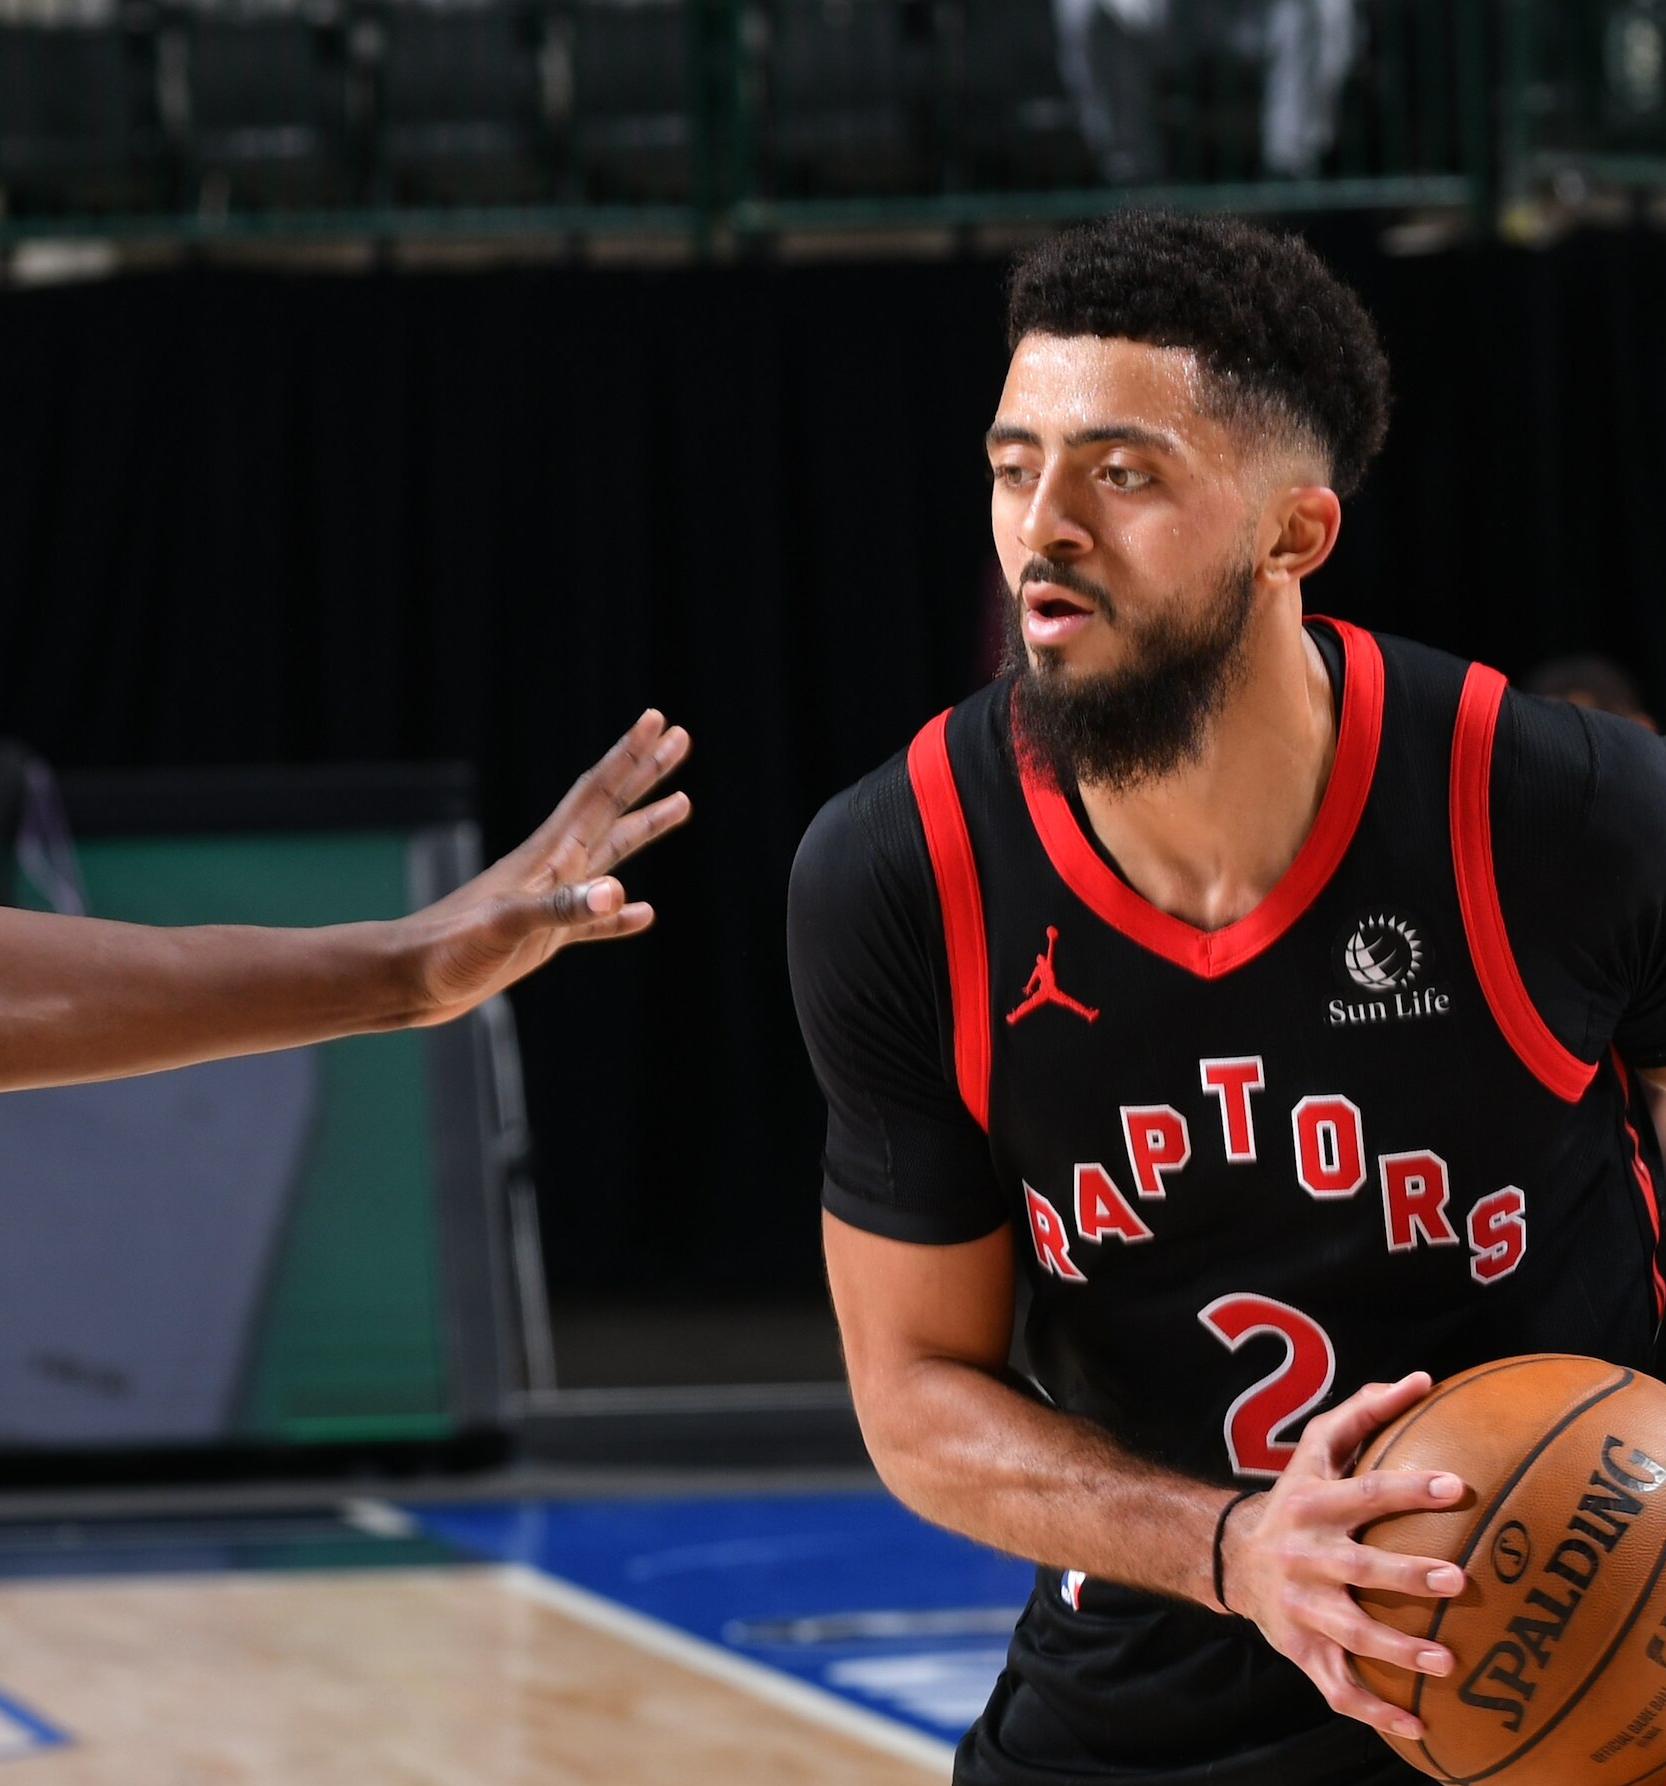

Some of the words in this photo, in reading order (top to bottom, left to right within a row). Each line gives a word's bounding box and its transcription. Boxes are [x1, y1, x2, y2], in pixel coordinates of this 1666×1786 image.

[1328, 999, 1387, 1025] Sun
[1394, 987, 1451, 1017] Life
[1022, 1055, 1528, 1285] RAPTORS
[1197, 1292, 1336, 1479] 2
[1589, 1730, 1636, 1764] OFFICIAL
